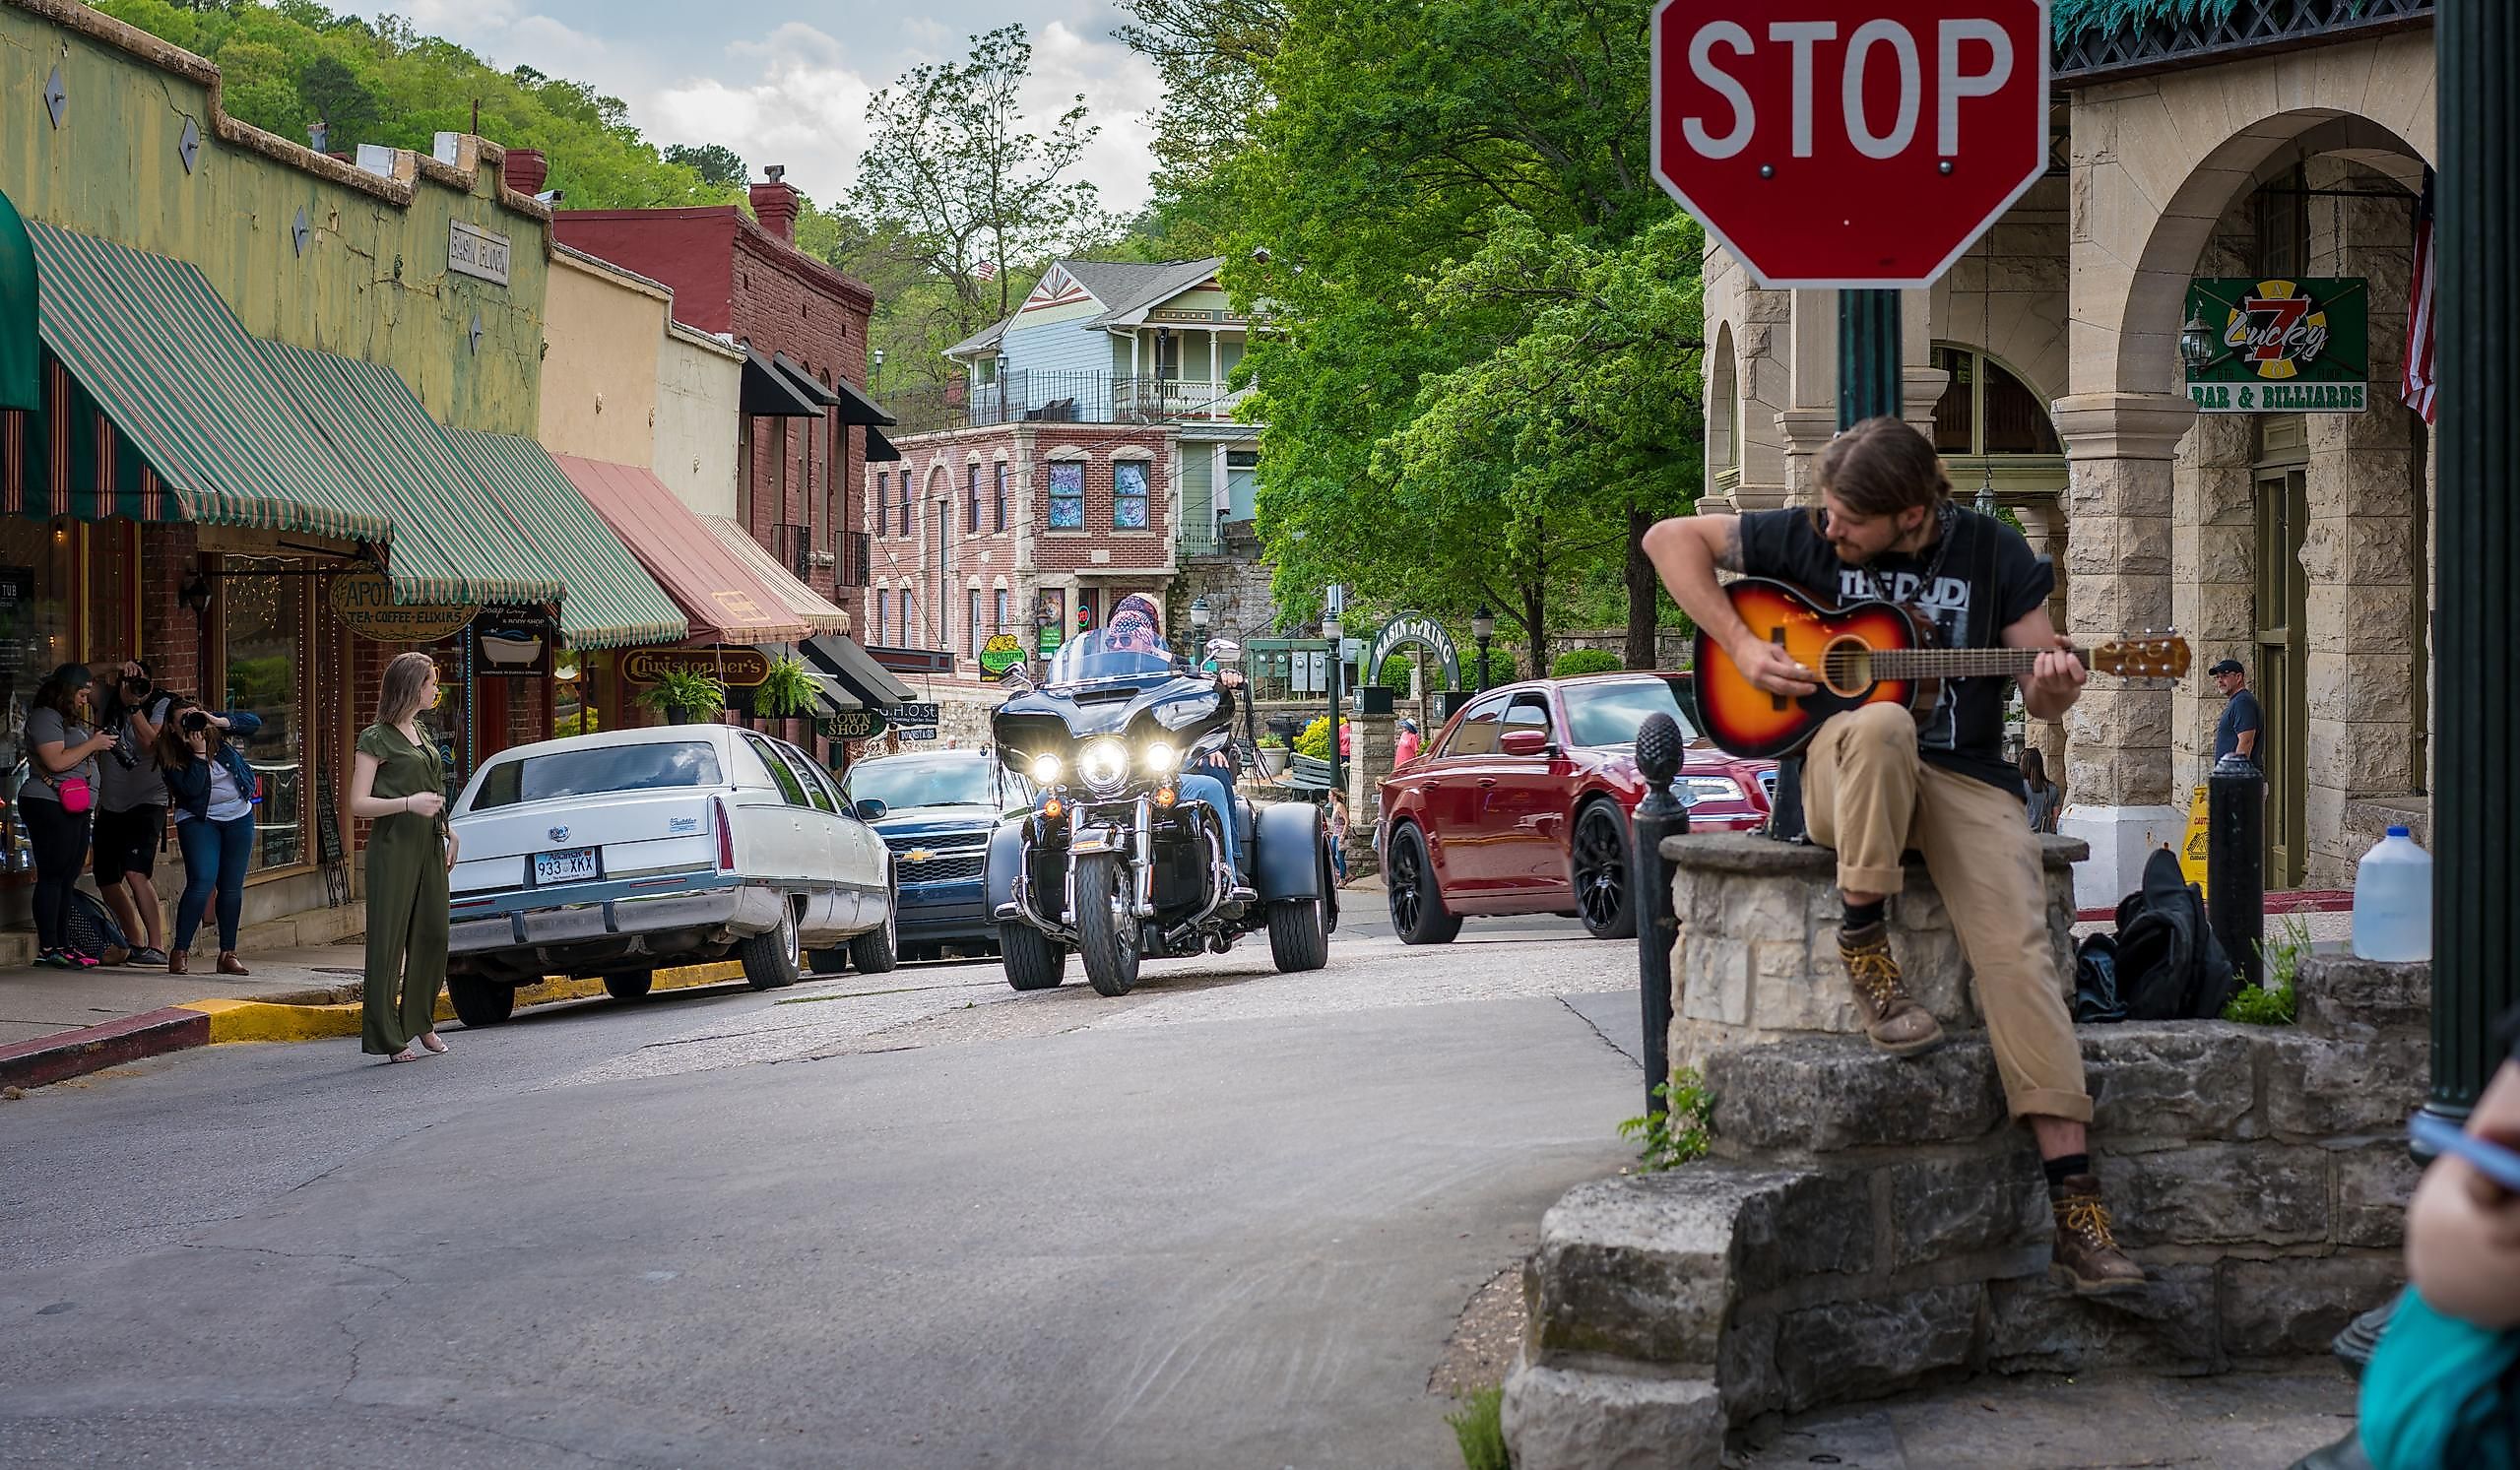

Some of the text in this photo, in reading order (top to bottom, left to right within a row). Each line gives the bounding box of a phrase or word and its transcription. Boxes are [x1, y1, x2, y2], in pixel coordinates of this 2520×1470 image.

[1682, 18, 2014, 160] STOP
[451, 235, 507, 277] BASIN BLOCK
[2224, 311, 2329, 361] Lucky
[2244, 294, 2312, 362] 7
[2191, 385, 2362, 409] BAR & BILLIARDS
[1375, 617, 1407, 665] BASIN
[828, 713, 872, 725] TOWN
[828, 724, 870, 735] SHOP
[2194, 816, 2208, 826] CAUT
[538, 857, 593, 876] 933 XKX
[549, 850, 582, 862] Arkansas
